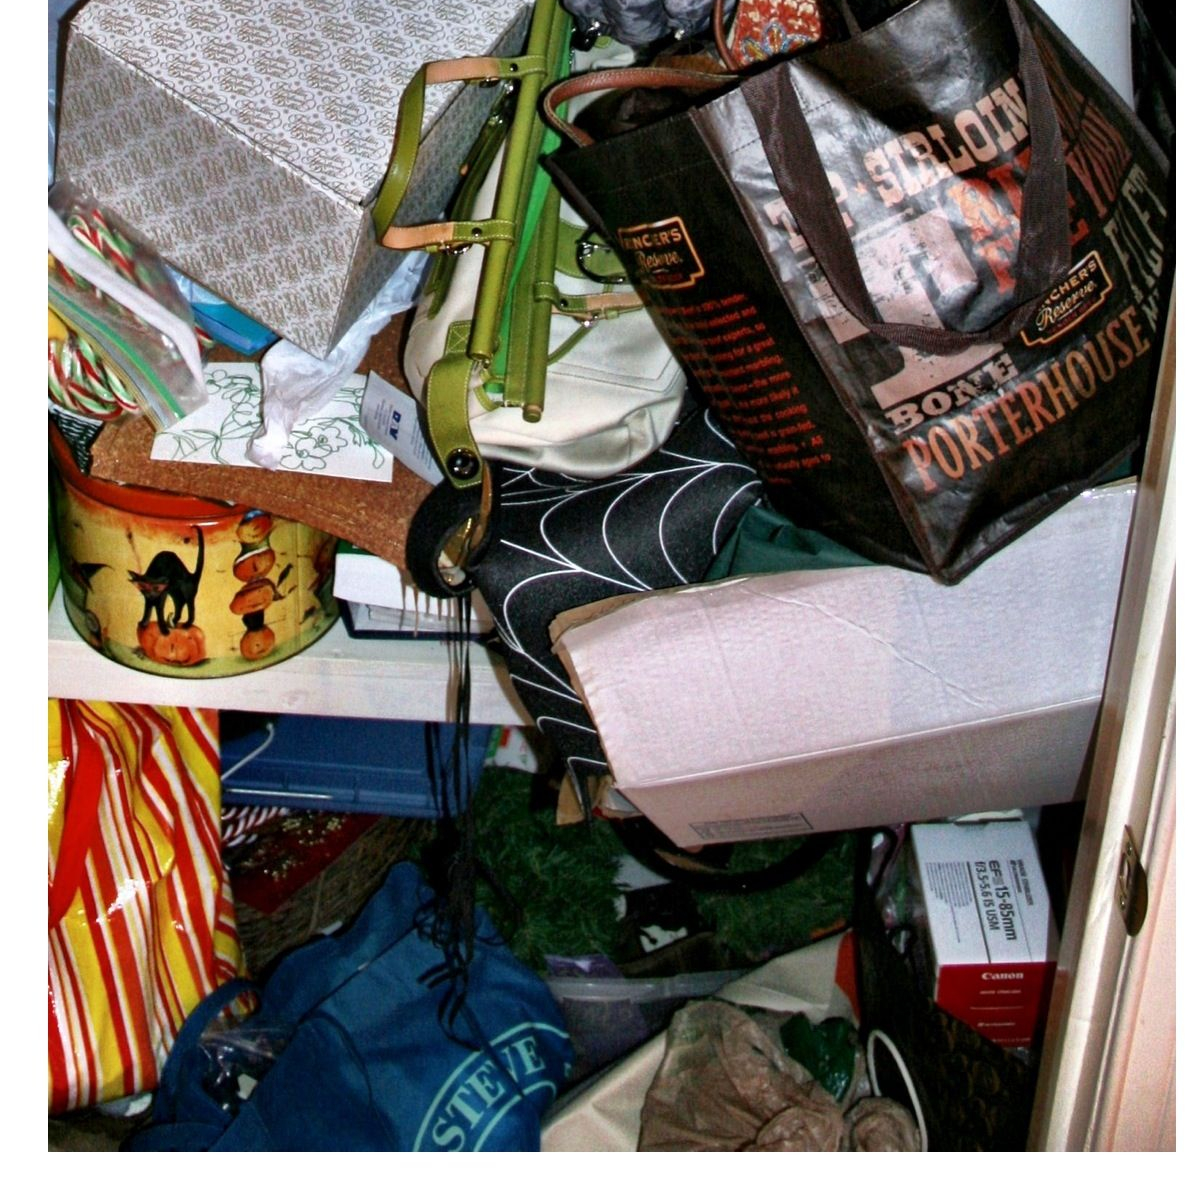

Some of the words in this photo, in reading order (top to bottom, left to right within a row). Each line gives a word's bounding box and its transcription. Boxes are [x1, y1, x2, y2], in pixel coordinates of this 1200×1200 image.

[863, 77, 1030, 208] SIRLOIN
[885, 353, 1019, 435] BONE
[903, 305, 1150, 492] PORTERHOUSE
[985, 910, 1000, 931] USM
[995, 886, 1017, 941] 15-85mm
[981, 972, 1024, 980] Canon
